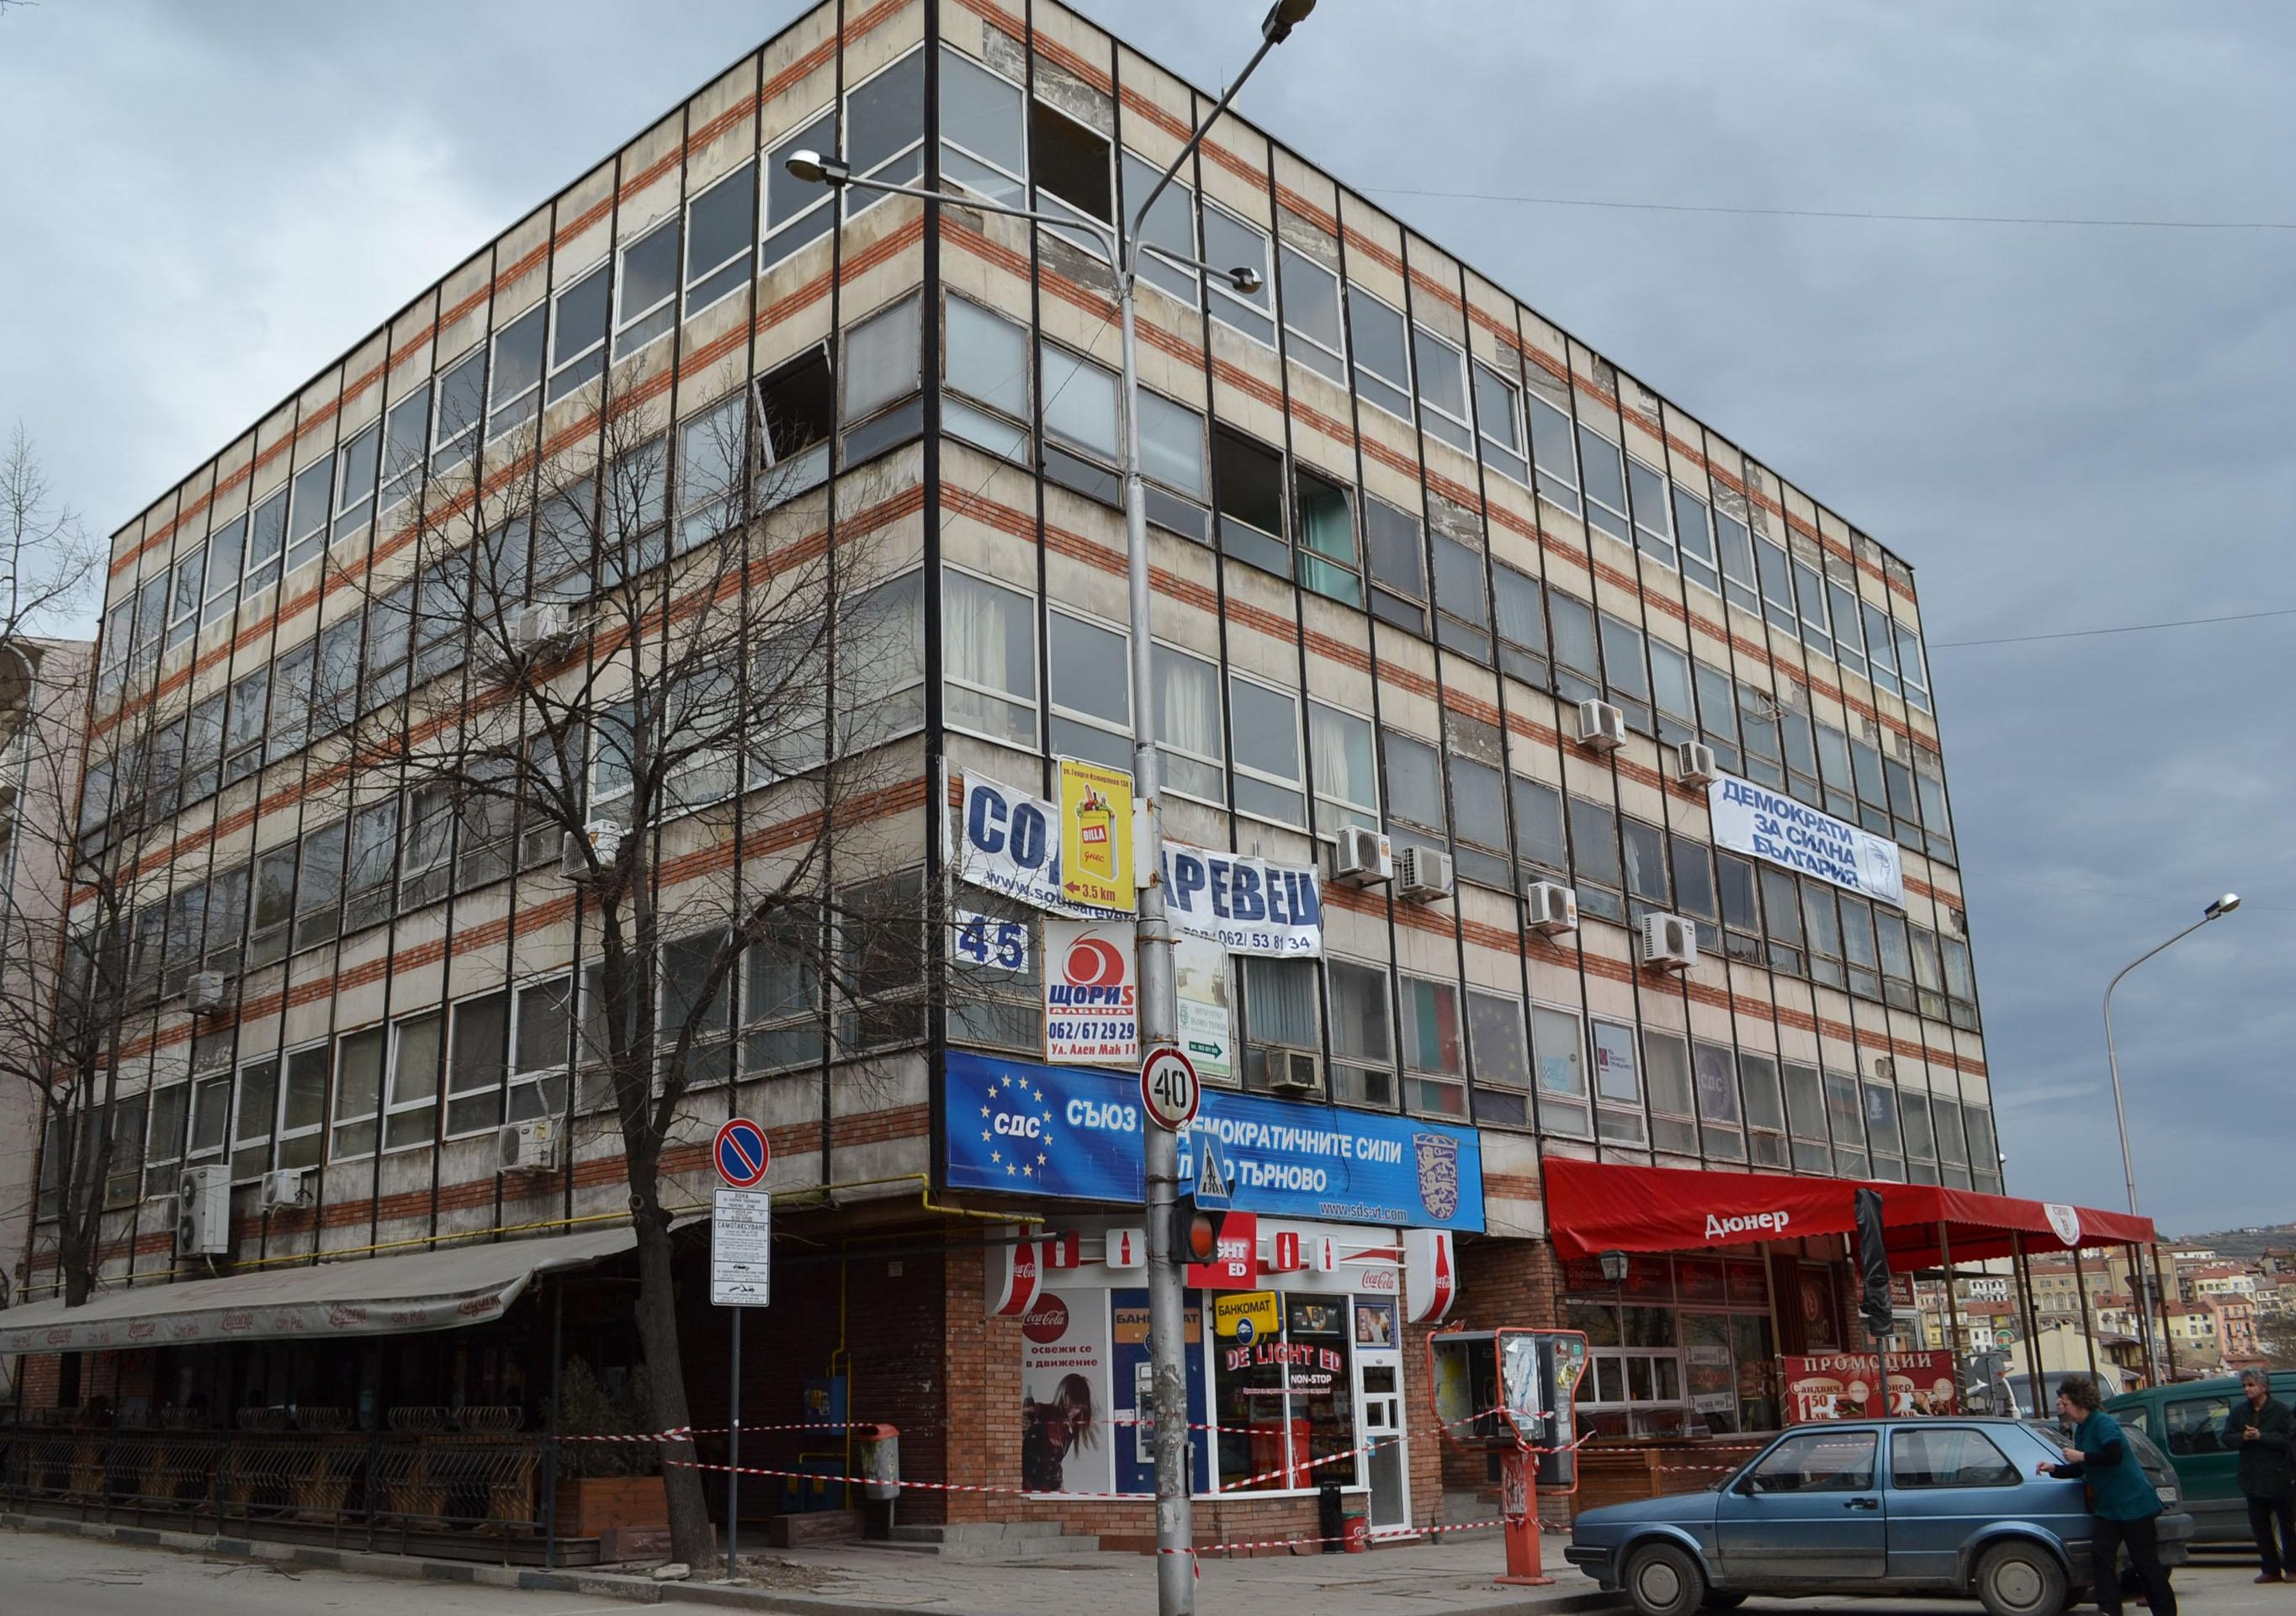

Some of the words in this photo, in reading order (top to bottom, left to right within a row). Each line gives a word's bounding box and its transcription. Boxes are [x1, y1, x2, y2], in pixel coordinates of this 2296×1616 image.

[1723, 779, 1853, 845] ДЕМОКРАТИ
[1083, 826, 1106, 841] BILLA
[1754, 813, 1781, 840] ЗА
[1786, 826, 1857, 867] СИЛНА
[969, 786, 1059, 885] СО
[1163, 850, 1320, 932] АРЕВЕЦ
[1752, 834, 1859, 888] БЪЛГАРИЯ
[1083, 884, 1098, 899] 3.5
[1100, 887, 1116, 902] km
[959, 915, 1023, 968] 45
[1252, 933, 1270, 948] 53
[1288, 936, 1311, 950] 34
[1069, 1043, 1095, 1055] Ален
[1098, 1043, 1121, 1055] Мак
[1124, 1043, 1136, 1055] 11
[1153, 1068, 1187, 1109] 40
[994, 1113, 1041, 1138] СДС
[1067, 1099, 1137, 1132] СЪЮЗ
[1355, 1136, 1403, 1164] СИЛИ
[1238, 1160, 1328, 1192] ТЪРНОВО
[1319, 1201, 1408, 1221] www.sds-vt.com
[717, 1221, 766, 1231] САМОТАКСУВАНЕ
[1705, 1211, 1790, 1240] Дюнер
[1217, 1242, 1247, 1258] GHT
[1228, 1263, 1247, 1277] ED
[1217, 1299, 1271, 1317] БАНКОМАТ
[1116, 1313, 1200, 1325] БАНАТ
[1031, 1345, 1077, 1354] освежи
[1079, 1345, 1092, 1354] се
[1226, 1346, 1250, 1371] DE
[1256, 1343, 1313, 1365] LIGHT
[1319, 1348, 1342, 1373] ED
[1026, 1359, 1032, 1368] в
[1036, 1359, 1098, 1369] движение
[1803, 1353, 1933, 1372] ПРОМОЦИИ
[1290, 1374, 1332, 1385] NON-STOP
[1790, 1382, 1841, 1395] Сандвич
